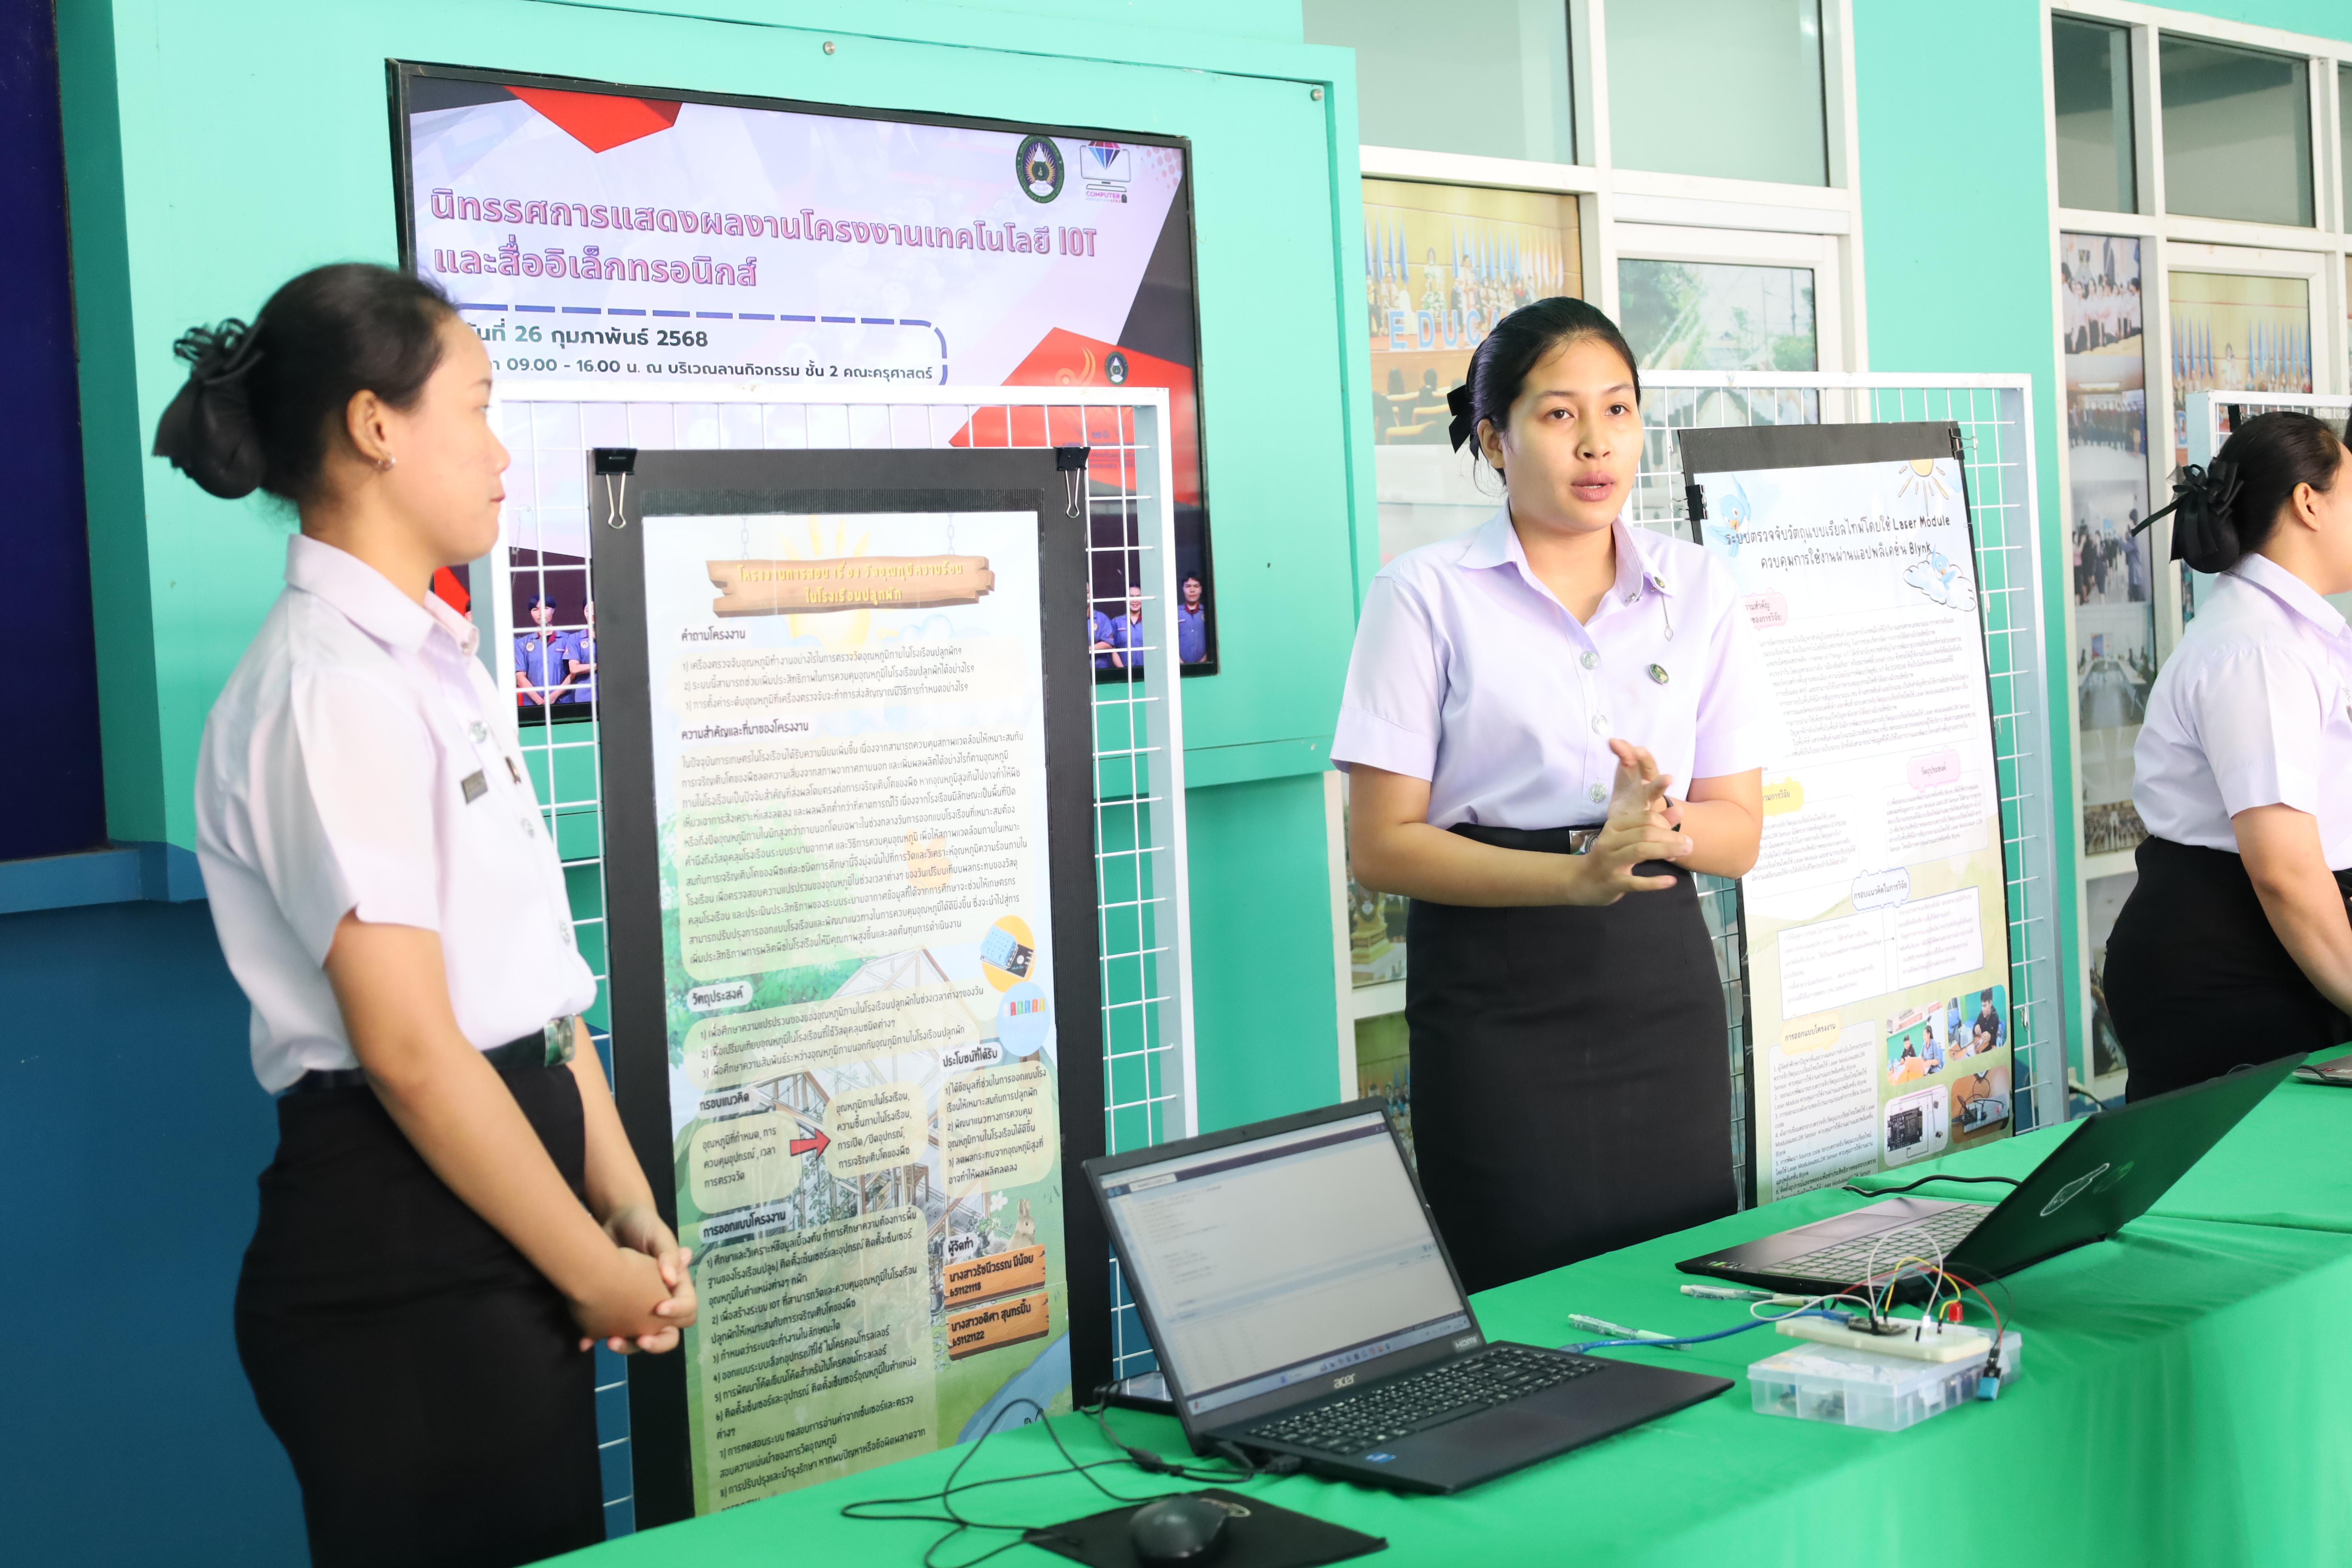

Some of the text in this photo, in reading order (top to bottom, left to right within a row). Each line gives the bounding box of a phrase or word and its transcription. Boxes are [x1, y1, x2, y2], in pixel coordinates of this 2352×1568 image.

[430, 187, 1098, 257] นิทรรศการแสดงผลงานโครงงานเทคโนโลยี IOT
[434, 234, 758, 287] และสื่ออิเล็กทรอนิกส์
[467, 318, 708, 348] ันที่ 26 กุมภาพันธ์ 2568
[507, 358, 557, 371] 09.00
[576, 360, 621, 373] 16.00
[627, 363, 640, 373] น.
[646, 363, 662, 374] ณ
[668, 361, 800, 377] บริเวณลานกิจกรรม
[805, 360, 824, 377] ชั้น
[830, 365, 838, 377] 2
[844, 366, 933, 383] คณะครุศาสตร์
[1892, 518, 1917, 531] Laser
[1919, 514, 1951, 528] Module
[1909, 541, 1932, 559] Blynk
[1751, 611, 1782, 623] ของการวิจัย:
[681, 625, 746, 642] คำถามโครงงาน
[686, 893, 714, 906] โรงเรือน
[691, 985, 744, 1005] วัตถุประสงค์
[700, 1092, 749, 1110] กรอบแนวคิด
[703, 1210, 786, 1238] การออกแบบโครงงาน
[769, 1299, 781, 1310] IOT
[1333, 1373, 1356, 1389] acer
